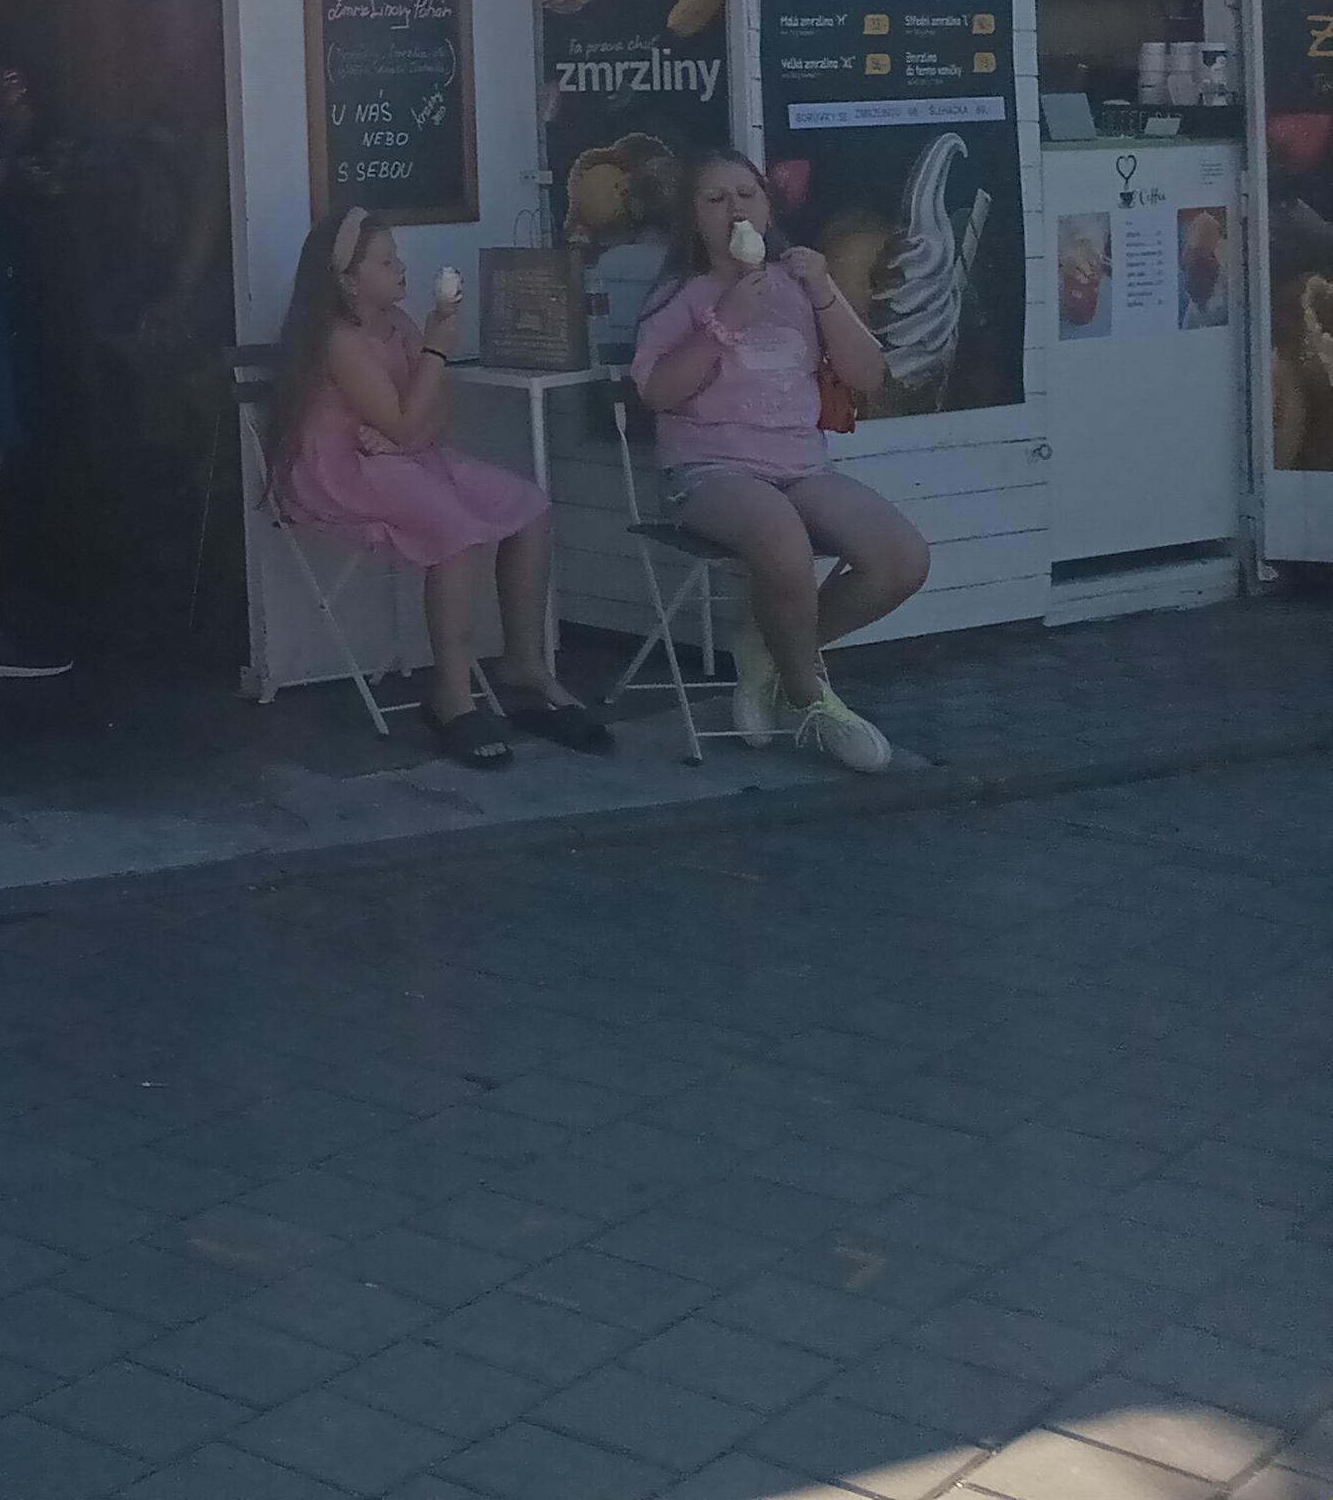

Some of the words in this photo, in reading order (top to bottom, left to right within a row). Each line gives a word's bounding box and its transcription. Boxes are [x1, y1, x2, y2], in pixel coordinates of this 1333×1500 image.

[556, 47, 721, 102] zmrzliny
[332, 104, 346, 125] U
[363, 131, 409, 147] NEBO
[337, 162, 348, 182] S
[356, 161, 413, 181] SEBOU
